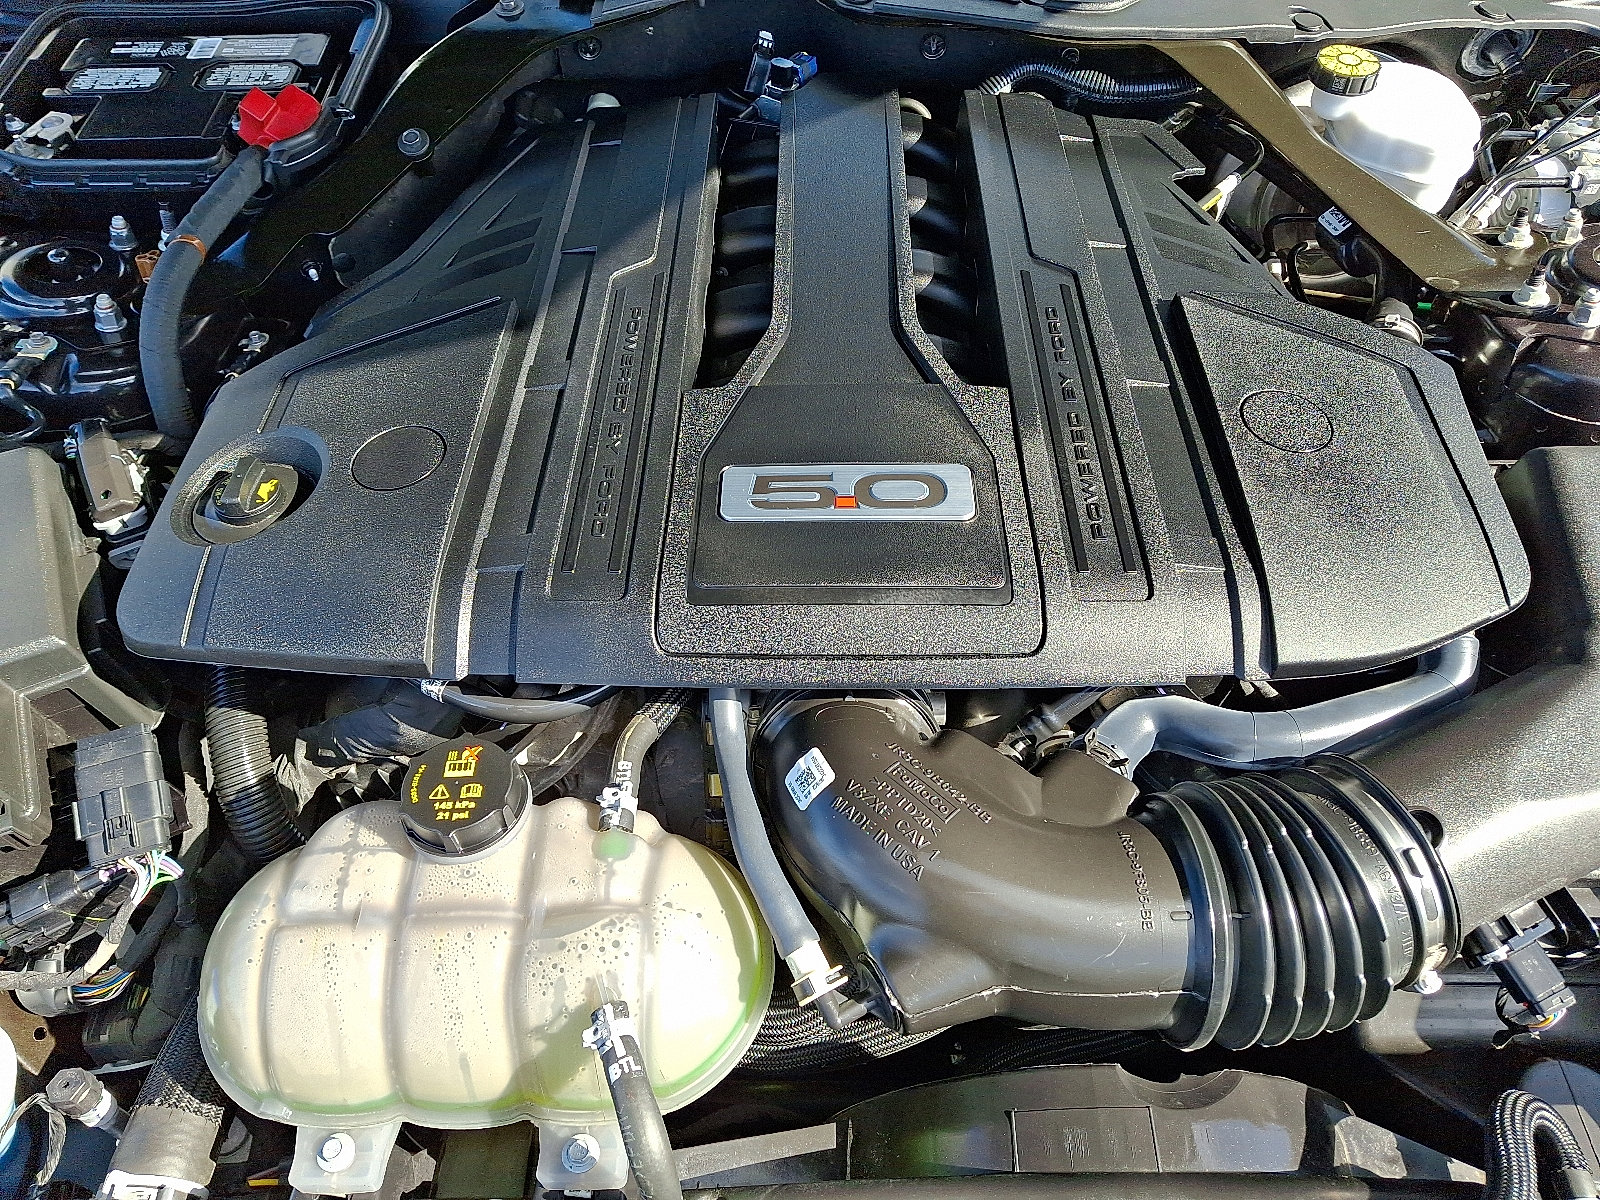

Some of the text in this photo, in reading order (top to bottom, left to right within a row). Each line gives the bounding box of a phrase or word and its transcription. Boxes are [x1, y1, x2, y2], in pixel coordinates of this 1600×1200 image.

[590, 306, 643, 538] POWERED BY FORD
[1045, 306, 1108, 542] POWERED BY FORD
[746, 471, 948, 511] 5.0
[433, 800, 476, 810] 145 kPa
[435, 810, 470, 821] 21 psi
[831, 796, 926, 882] MADE IN USA
[894, 818, 932, 850] CAV
[928, 848, 942, 862] 1
[608, 1056, 642, 1086] BTL
